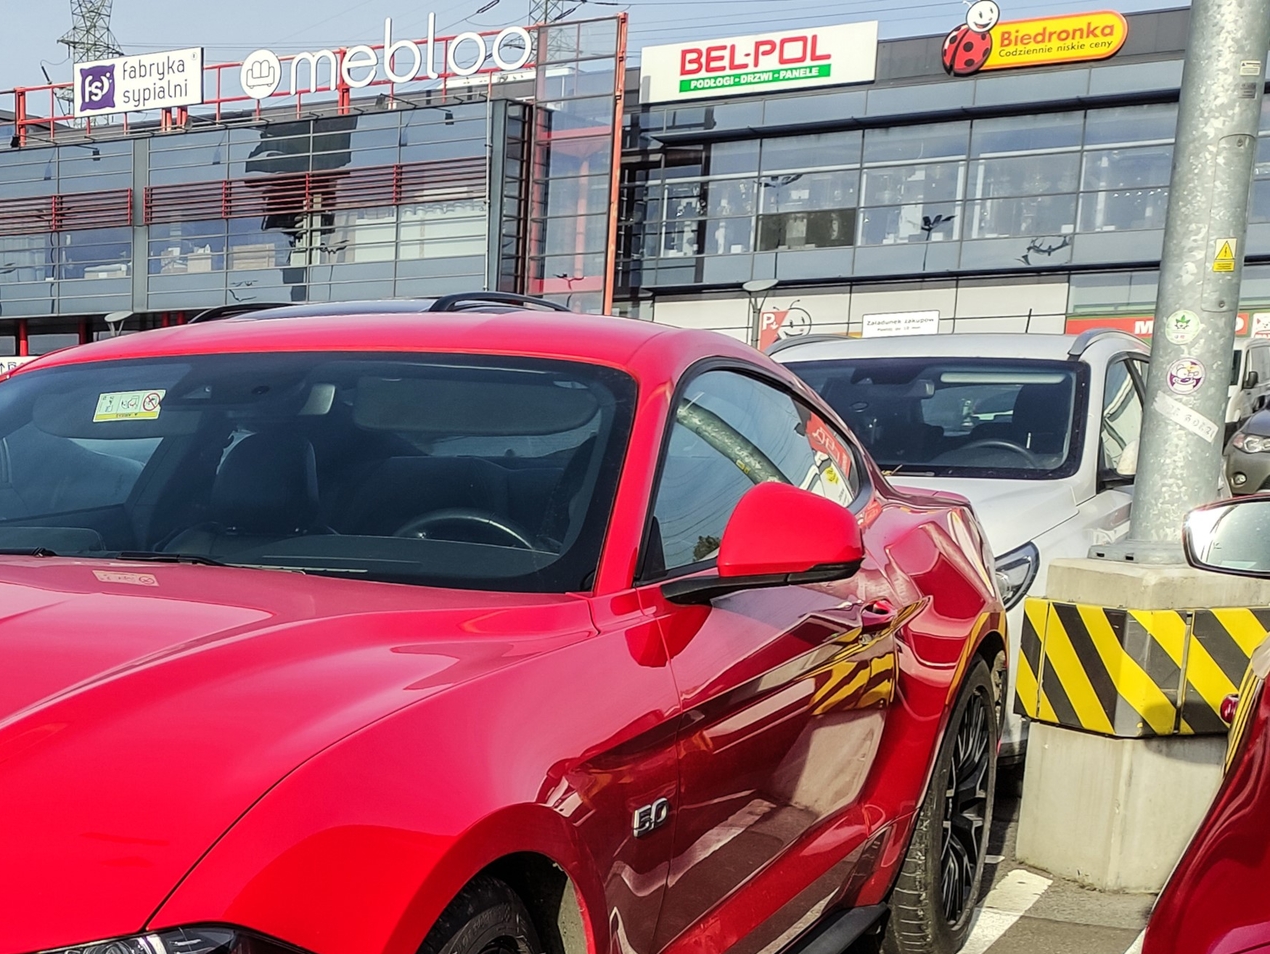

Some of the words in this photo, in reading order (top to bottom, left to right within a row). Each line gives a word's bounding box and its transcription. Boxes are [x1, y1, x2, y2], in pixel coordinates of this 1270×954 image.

[999, 22, 1115, 48] Biedronka
[289, 12, 532, 96] mebloo
[679, 34, 832, 76] BEL-POL
[998, 45, 1053, 58] Codziennie
[1056, 42, 1086, 52] niskie
[1089, 40, 1113, 49] ceny
[122, 55, 186, 81] fabryka
[690, 75, 734, 90] PODŁOGI
[740, 72, 773, 84] DRZWI
[779, 67, 820, 79] PANELE
[122, 78, 188, 108] sypialni
